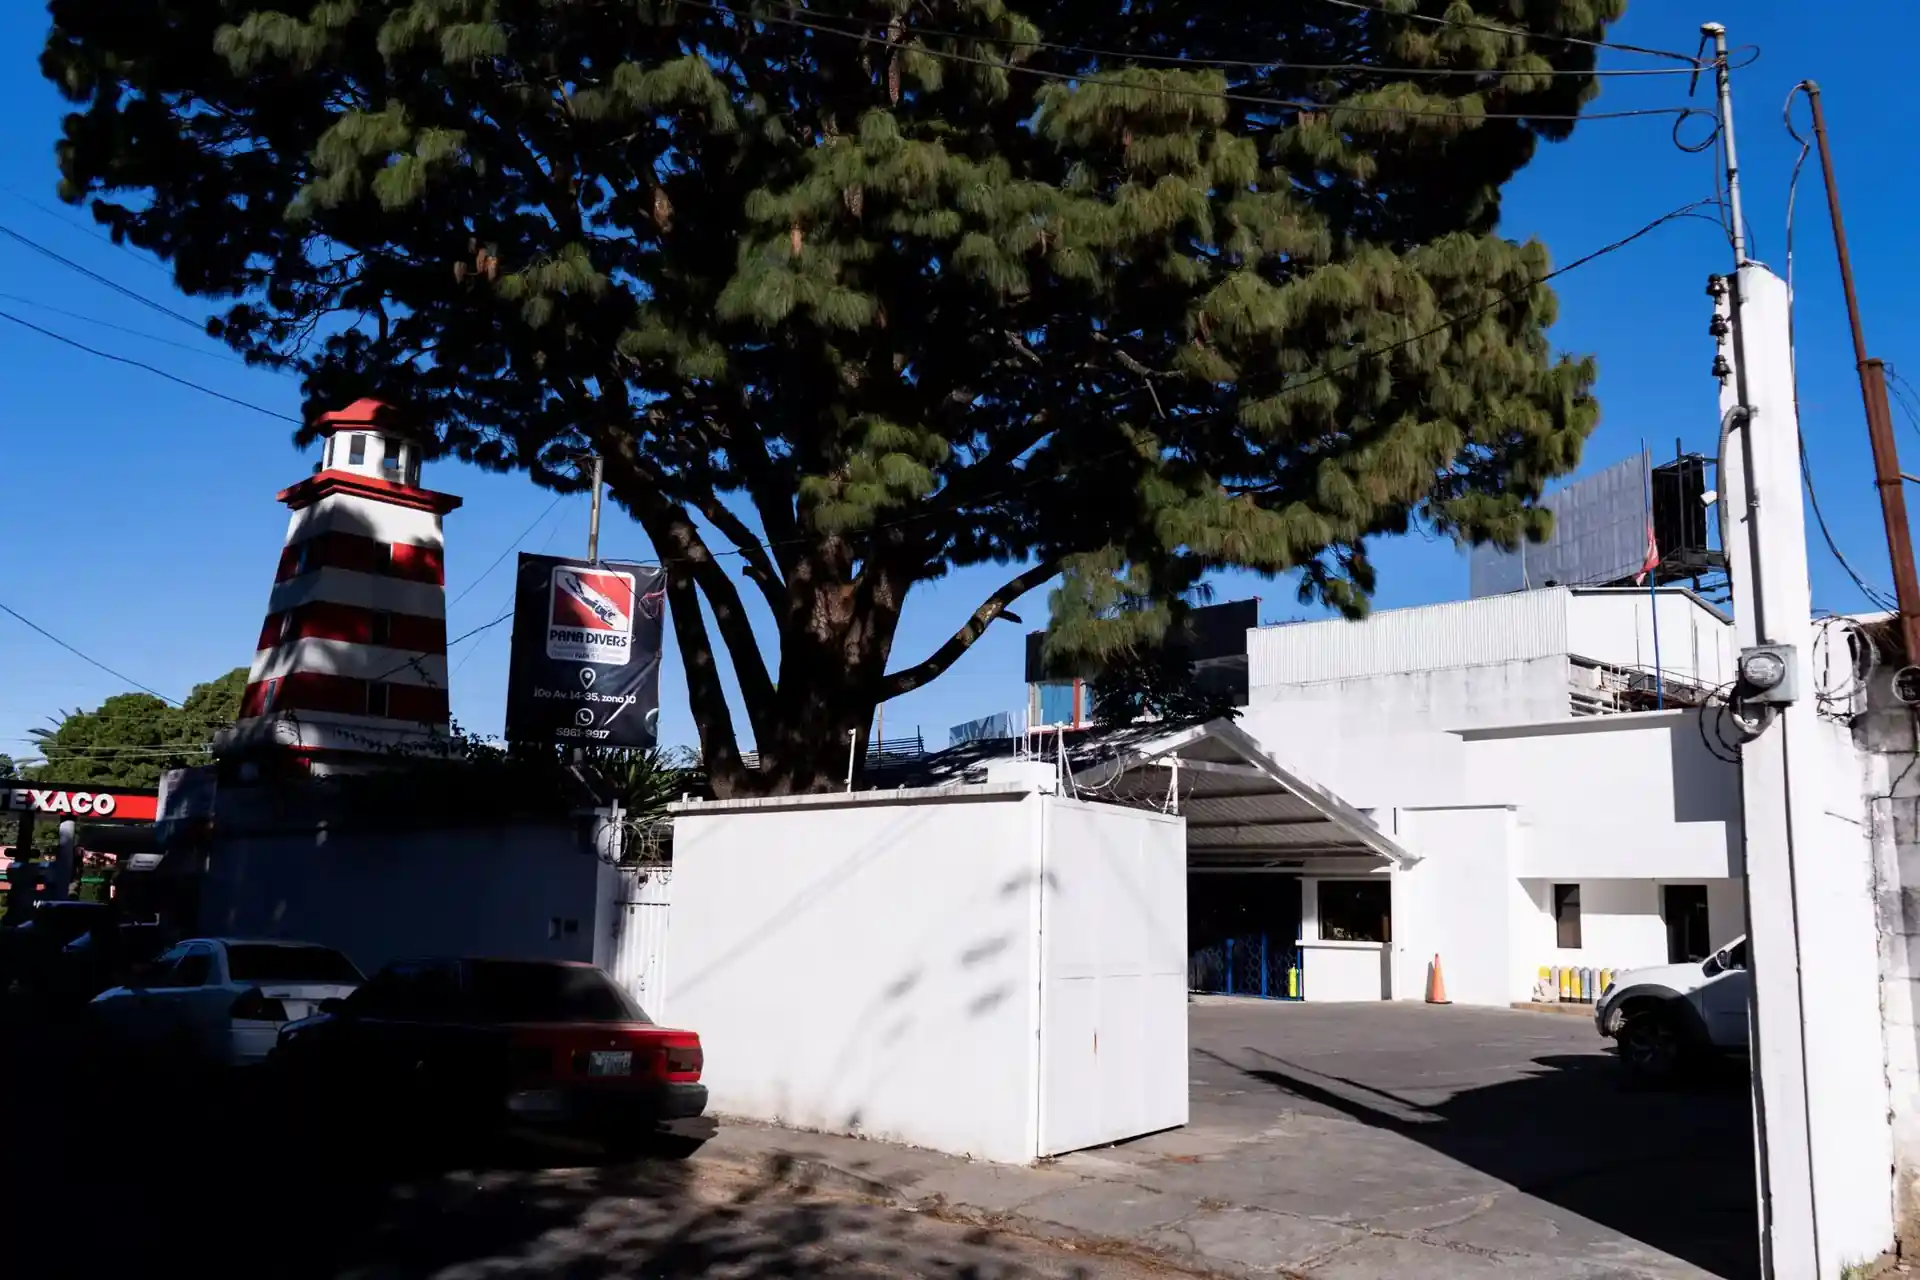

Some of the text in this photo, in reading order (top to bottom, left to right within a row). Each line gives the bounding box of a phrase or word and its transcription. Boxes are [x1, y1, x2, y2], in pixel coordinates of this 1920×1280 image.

[550, 630, 628, 647] PANA DIVERS
[602, 695, 623, 704] zona
[625, 695, 637, 704] 10
